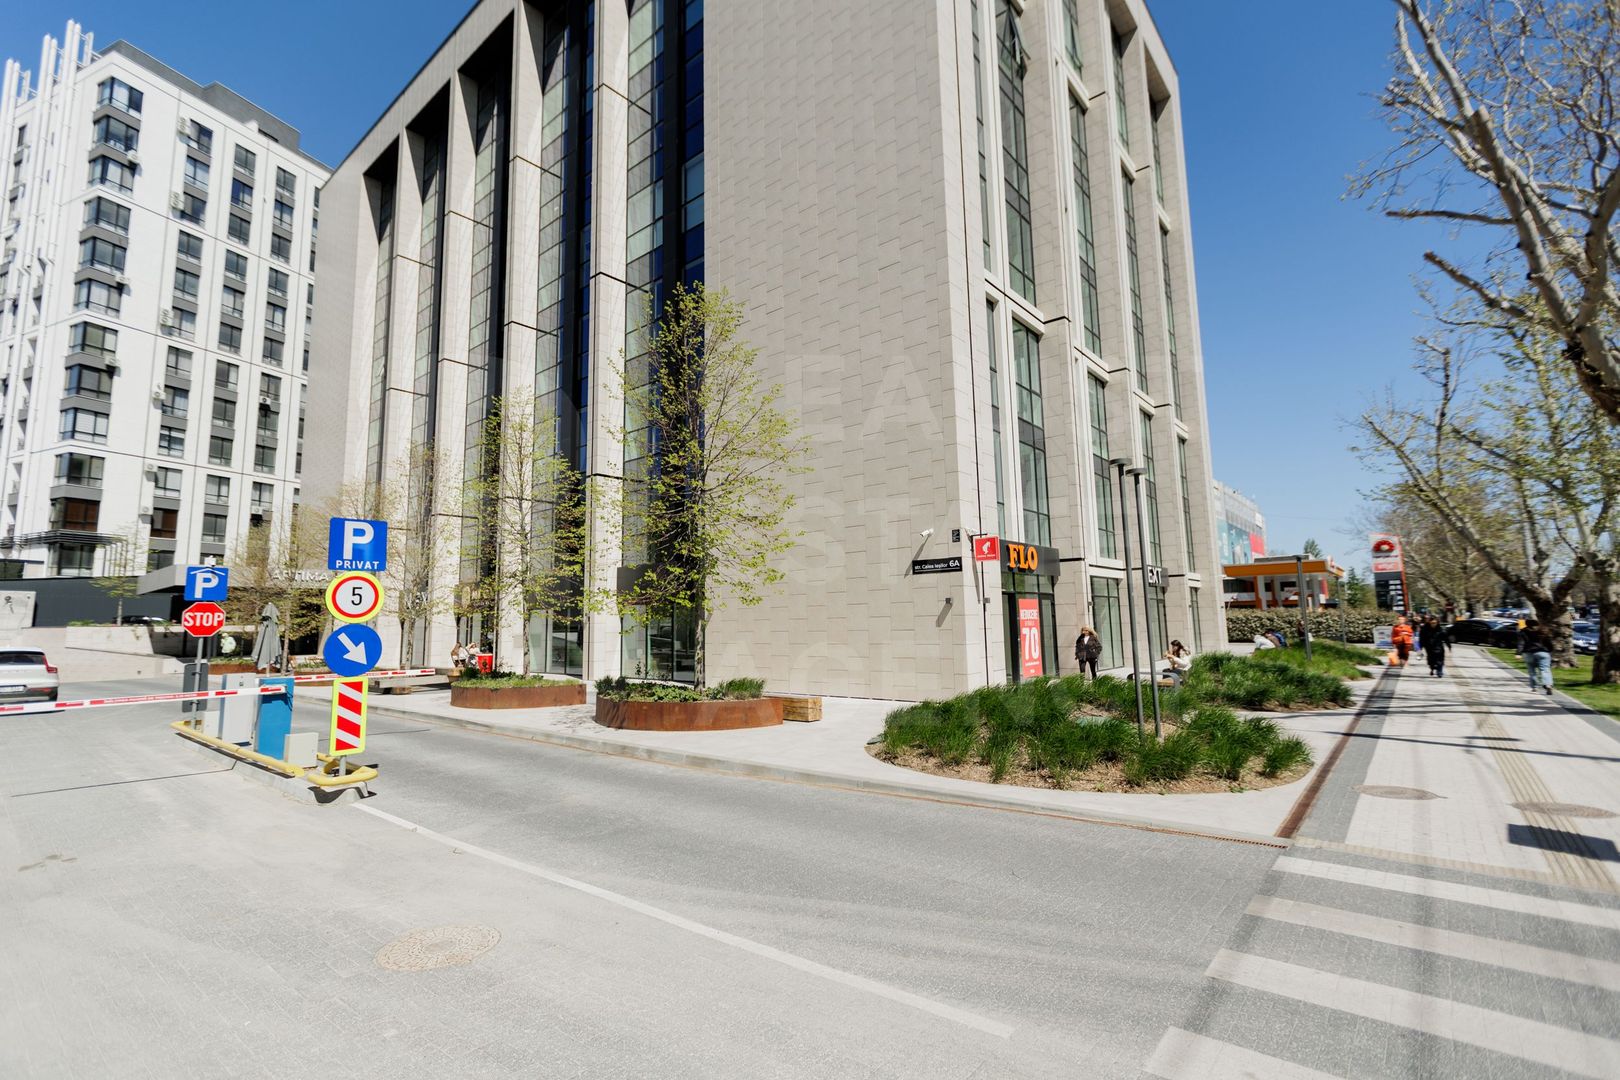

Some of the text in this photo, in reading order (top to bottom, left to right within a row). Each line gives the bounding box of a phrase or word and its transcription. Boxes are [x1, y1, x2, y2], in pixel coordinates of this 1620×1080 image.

[342, 520, 375, 560] P
[335, 559, 380, 570] PRIVAT
[949, 559, 960, 567] 6A
[1007, 543, 1039, 571] FLO
[194, 572, 220, 599] P
[350, 586, 363, 606] 5
[183, 612, 225, 627] STOP
[1022, 627, 1040, 660] 70
